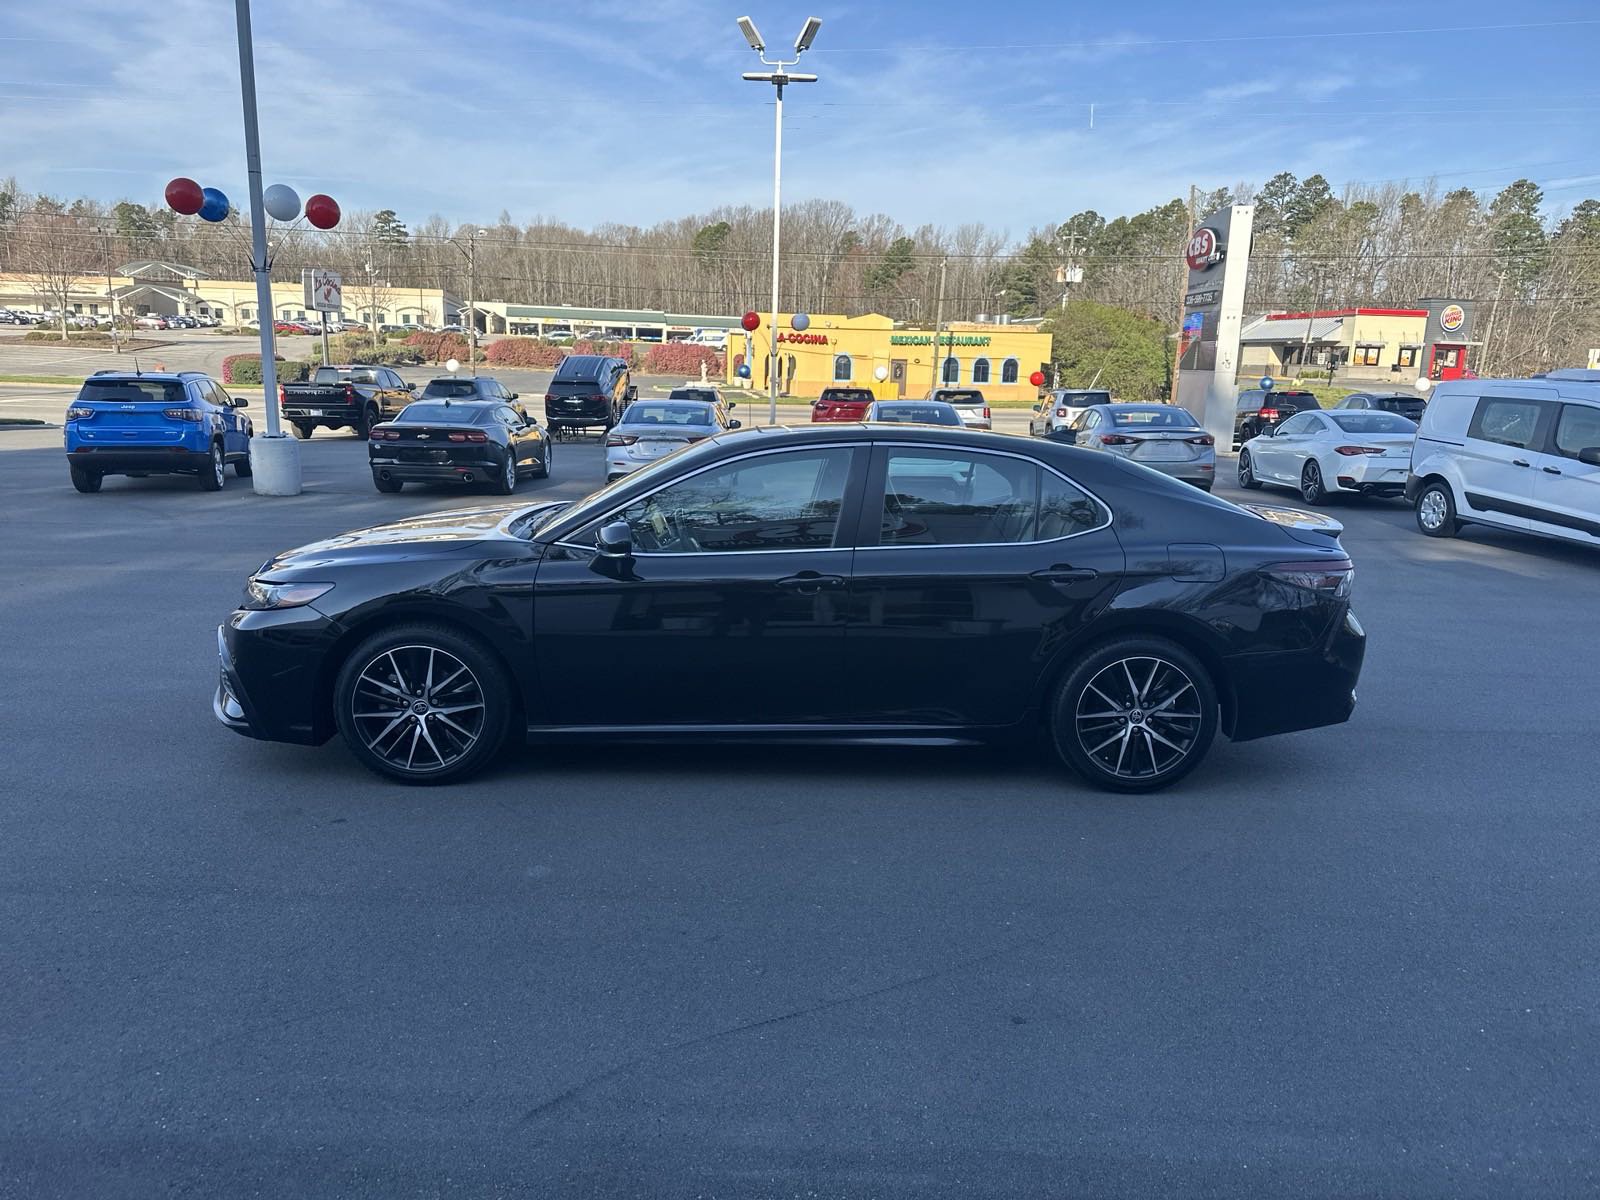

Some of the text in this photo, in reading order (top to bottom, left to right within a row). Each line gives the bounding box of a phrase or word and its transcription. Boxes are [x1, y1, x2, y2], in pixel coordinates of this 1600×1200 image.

[1189, 233, 1208, 257] CBS
[788, 333, 828, 345] COCINA
[891, 336, 991, 346] MEXICAN ESTAURANT
